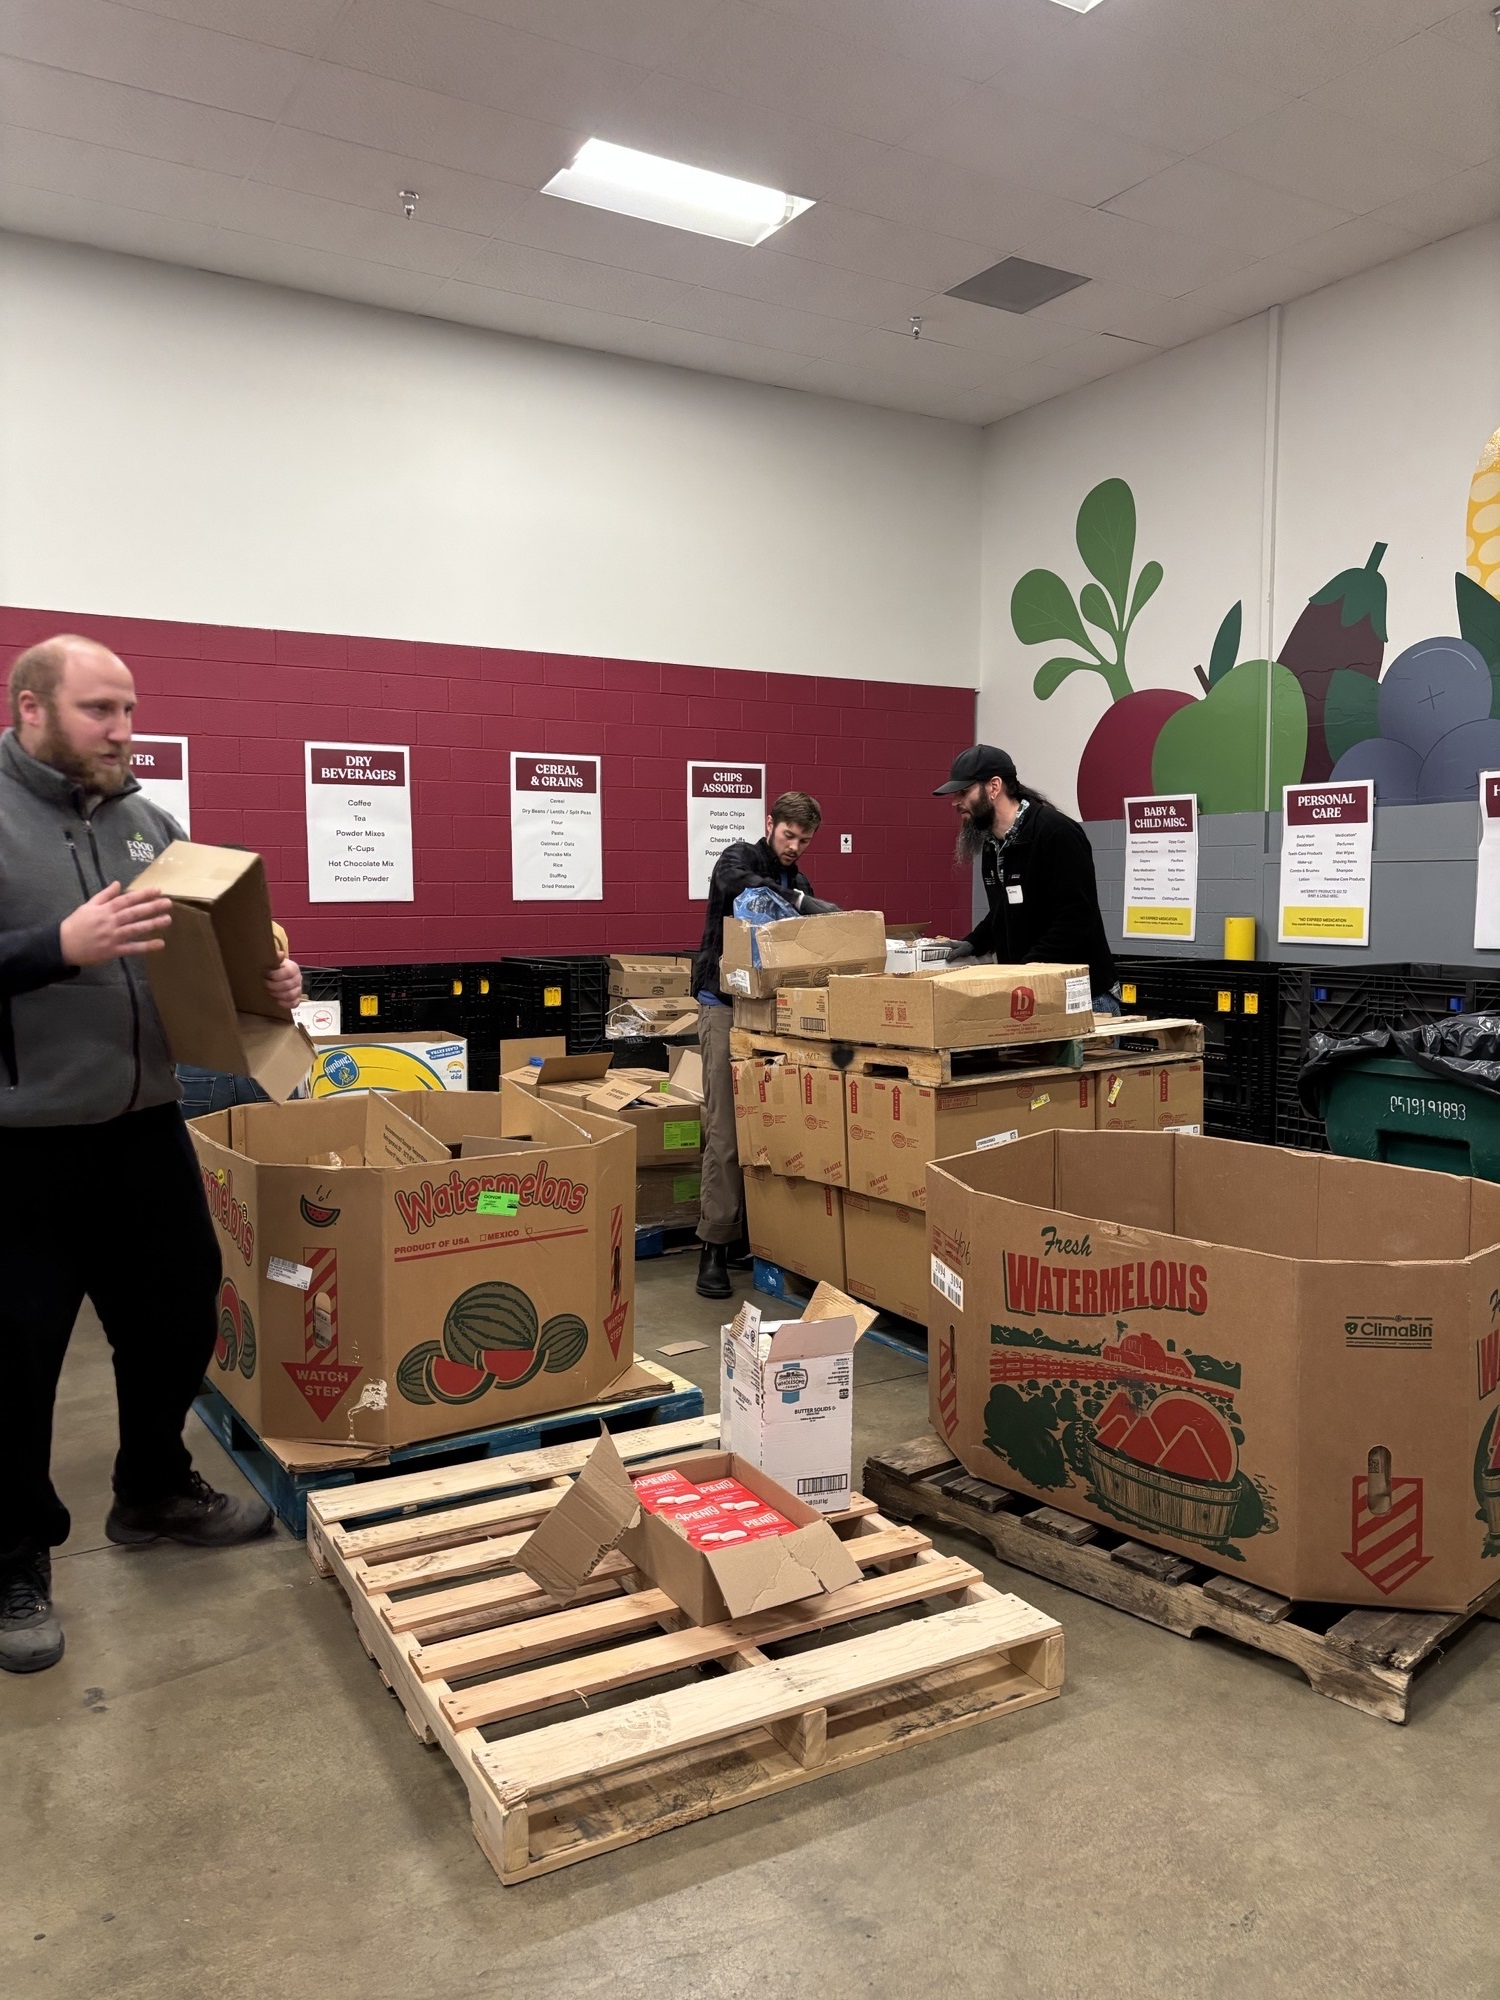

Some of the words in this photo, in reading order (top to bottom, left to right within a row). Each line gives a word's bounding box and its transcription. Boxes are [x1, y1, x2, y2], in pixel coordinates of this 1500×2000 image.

[130, 754, 155, 766] TER
[346, 756, 372, 766] DRY
[322, 768, 396, 780] BEVERAGES
[536, 764, 578, 776] CEREAL
[530, 776, 540, 786] &
[541, 777, 584, 788] GRAINS
[713, 772, 742, 782] CHIPS
[702, 784, 753, 794] ASSORTED
[1298, 793, 1356, 806] PERSONAL
[1144, 806, 1167, 816] BABY
[1169, 806, 1176, 815] &
[1312, 807, 1341, 819] CARE
[1135, 819, 1161, 828] CHILD
[1163, 817, 1187, 827] MISC.
[127, 840, 154, 851] FOOD
[324, 1055, 352, 1075] Chiquita
[785, 1152, 804, 1167] FRAGILE
[824, 1161, 842, 1174] FRAGILE
[869, 1174, 888, 1187] FRAGILE
[395, 1160, 588, 1234] Watermelons
[912, 1187, 926, 1198] FRAG
[201, 1166, 254, 1266] rmelons
[487, 1230, 519, 1240] MEXICO
[1041, 1226, 1092, 1256] Fresh
[394, 1242, 436, 1254] PRODUCT
[438, 1240, 449, 1249] OF
[452, 1237, 469, 1246] USA
[1003, 1250, 1208, 1316] WATERMELONS
[607, 1310, 624, 1330] WATCH
[610, 1328, 622, 1342] STEP
[1361, 1322, 1432, 1337] ClimaBin
[296, 1370, 349, 1381] WATCH
[305, 1386, 341, 1396] STEP
[632, 1473, 677, 1489] APLENTY
[675, 1506, 720, 1521] APLENTY
